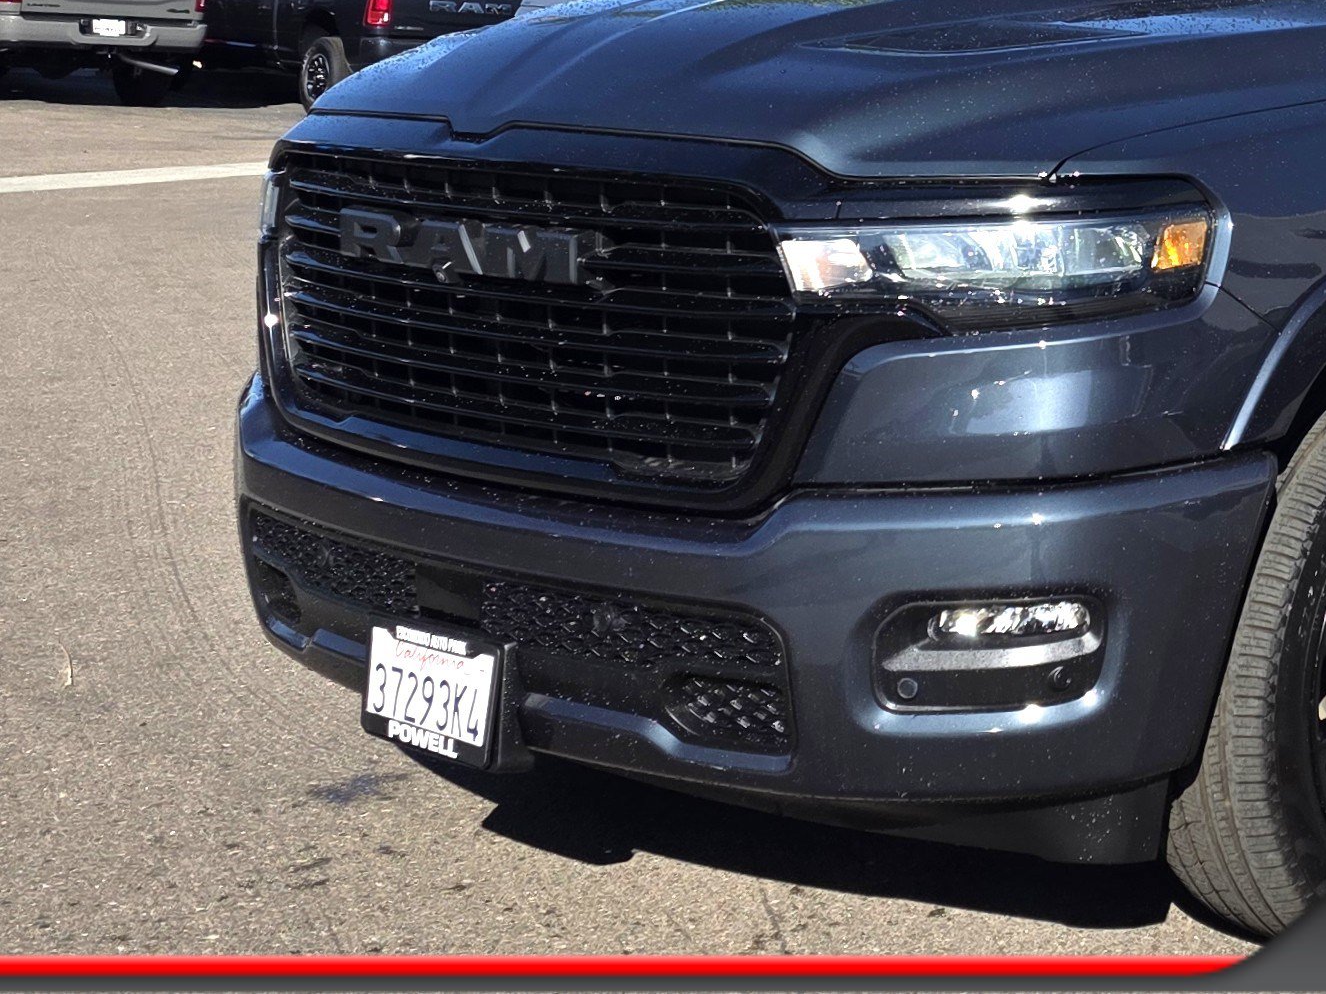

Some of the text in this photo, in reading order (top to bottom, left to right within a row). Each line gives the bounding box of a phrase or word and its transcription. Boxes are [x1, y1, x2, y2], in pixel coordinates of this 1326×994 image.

[428, 0, 513, 15] RAM
[339, 207, 580, 286] RAM
[372, 662, 480, 742] 37293K4
[387, 719, 459, 759] POWELL
